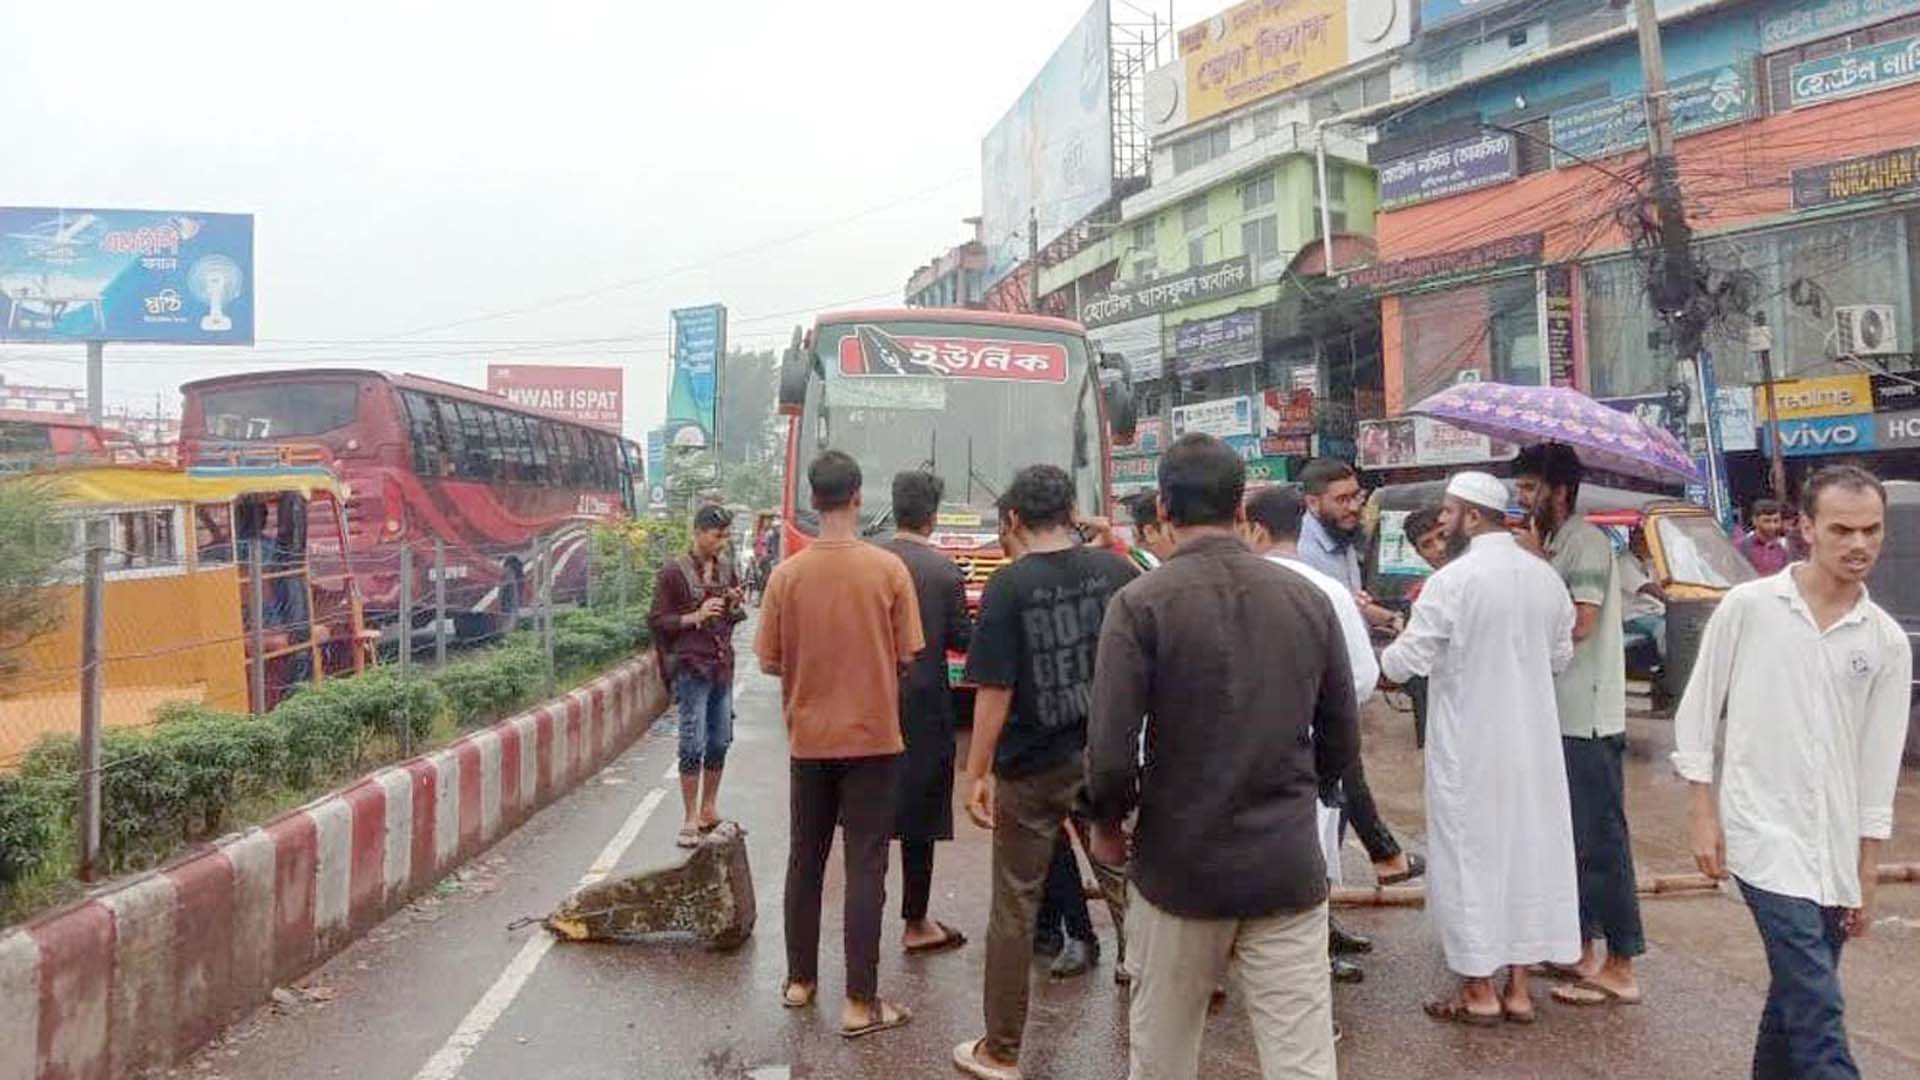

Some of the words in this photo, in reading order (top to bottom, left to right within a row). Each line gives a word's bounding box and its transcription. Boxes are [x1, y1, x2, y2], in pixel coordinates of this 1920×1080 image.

[1796, 57, 1877, 97] হোটেল
[1083, 294, 1133, 323] হোটেল
[909, 342, 1050, 375] ইউনিক
[569, 389, 618, 410] ISPAT
[1775, 388, 1852, 409] realme
[1779, 422, 1857, 447] vivo
